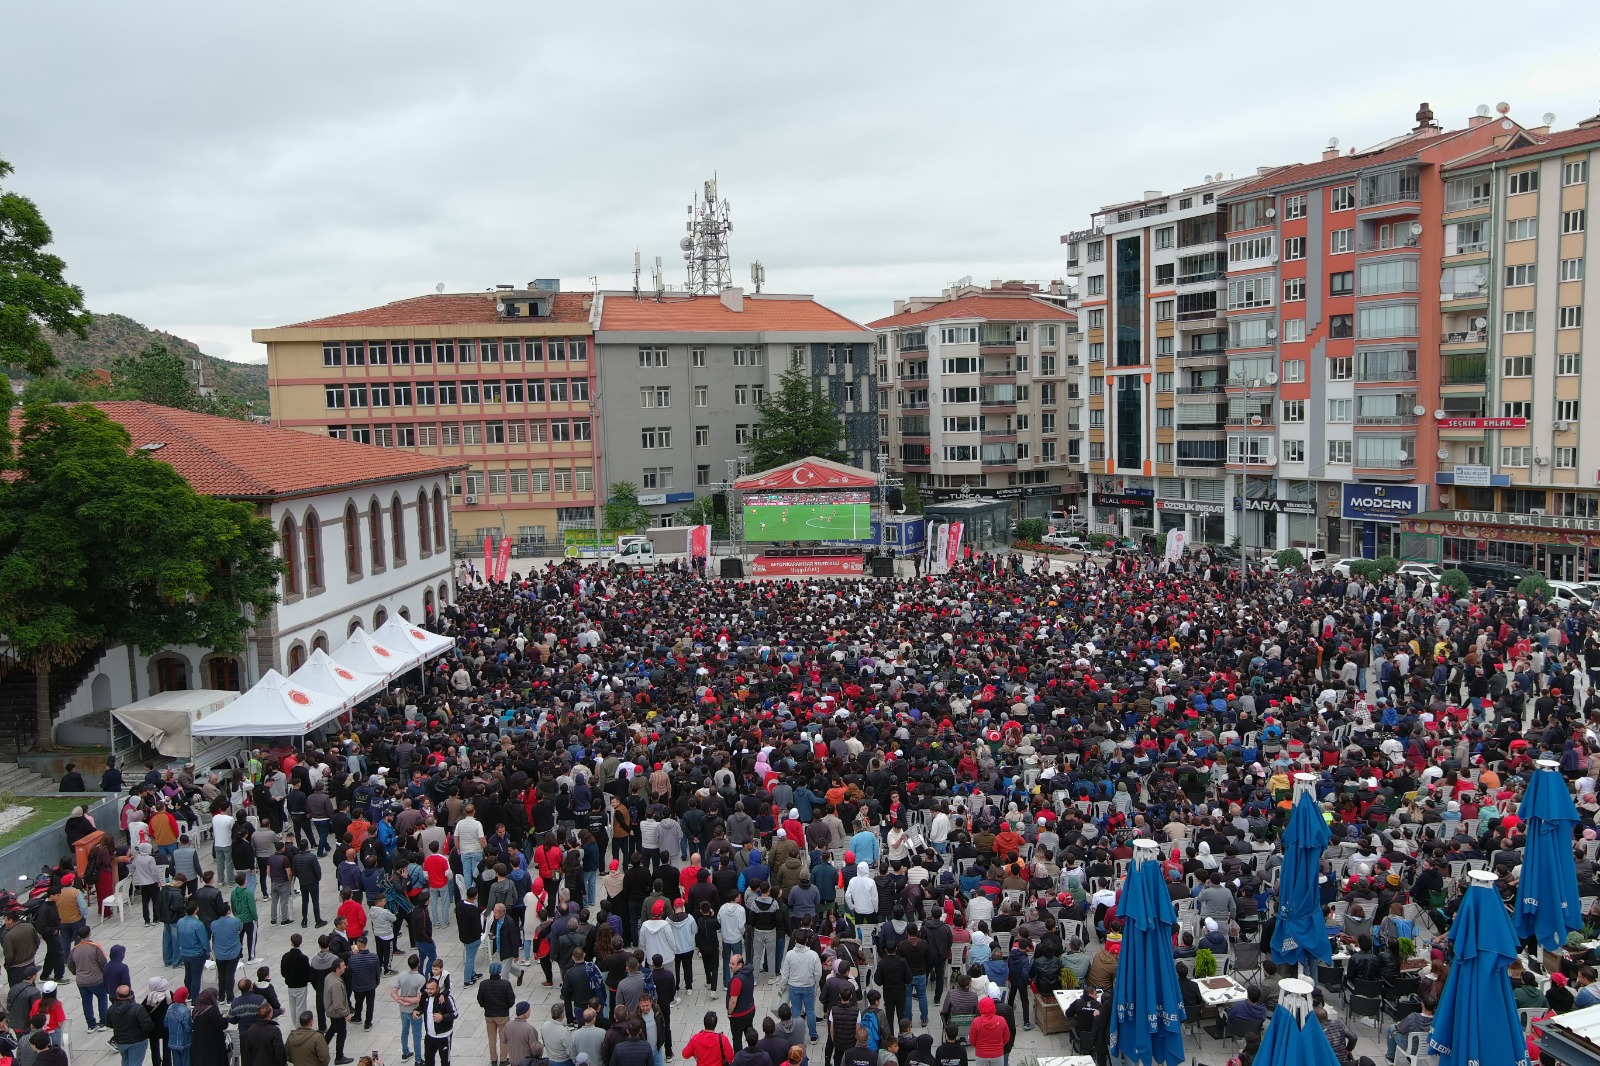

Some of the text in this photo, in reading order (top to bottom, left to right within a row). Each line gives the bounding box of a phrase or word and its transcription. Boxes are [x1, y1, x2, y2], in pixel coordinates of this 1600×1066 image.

[1449, 419, 1511, 428] SEÇKİN EMLAK
[1163, 501, 1195, 511] ÖZÇELİK
[1350, 497, 1412, 510] MODERN
[1454, 511, 1498, 524] KONYA
[1552, 518, 1600, 531] EKME
